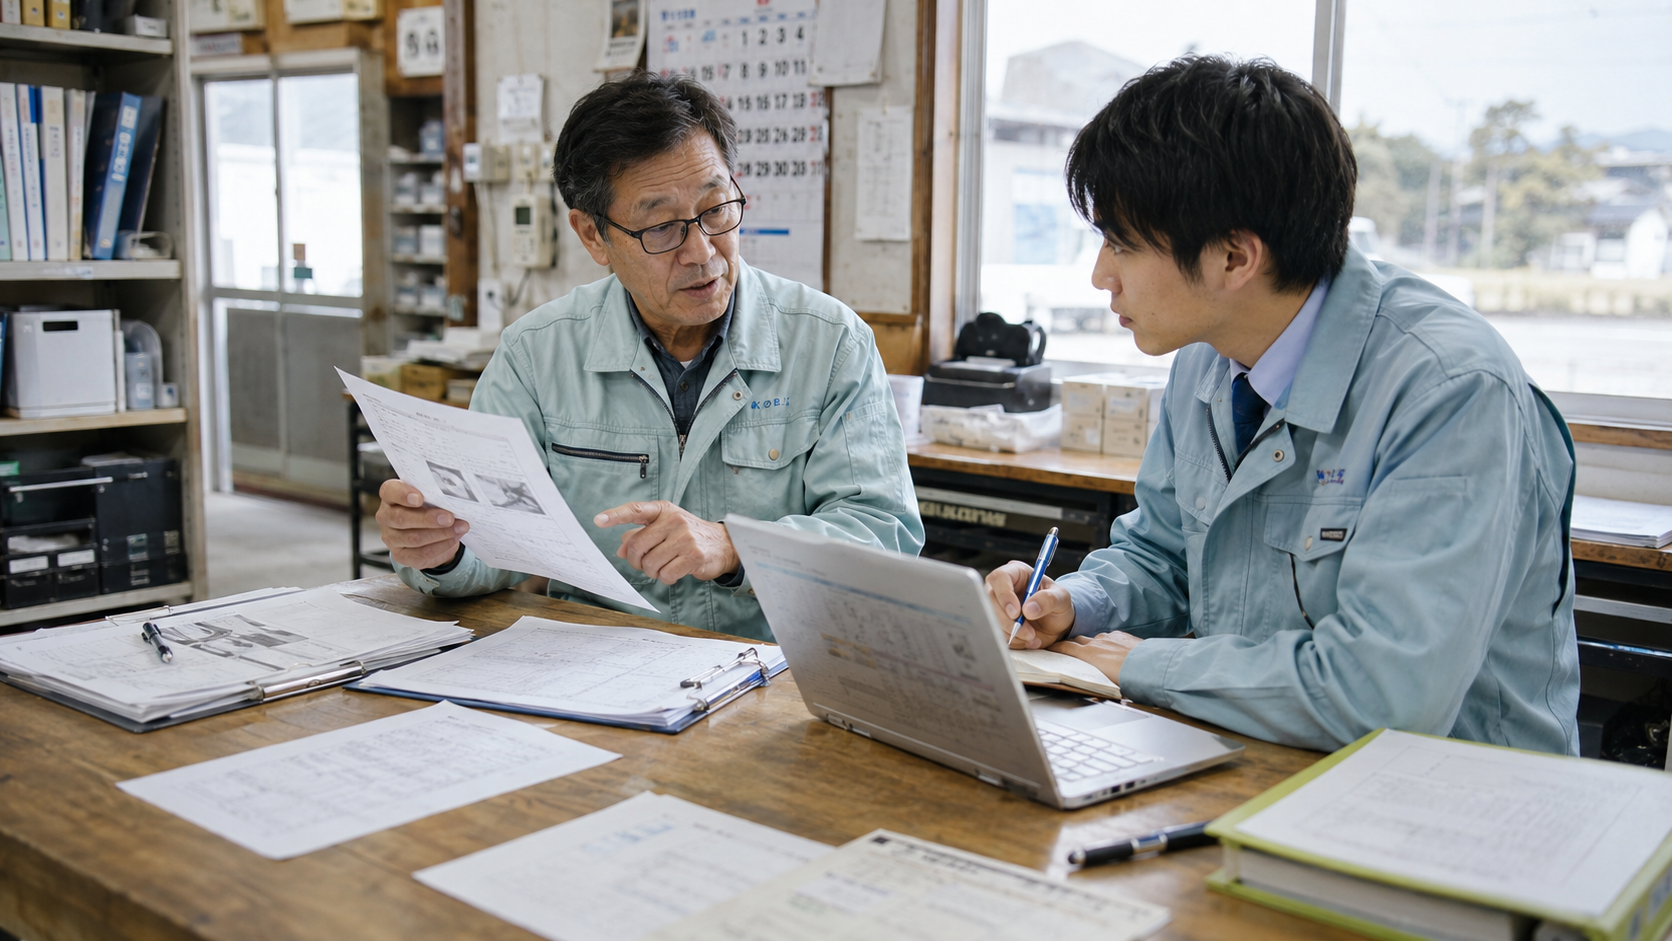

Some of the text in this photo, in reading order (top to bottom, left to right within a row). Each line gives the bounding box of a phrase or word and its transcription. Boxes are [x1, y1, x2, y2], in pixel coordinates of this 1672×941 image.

[741, 26, 804, 46] 1 2 3 4
[740, 62, 749, 79] 8
[757, 61, 767, 78] 9
[775, 60, 789, 77] 10
[794, 60, 806, 76] 11
[738, 94, 752, 111] 15
[756, 93, 771, 110] 16
[774, 93, 788, 109] 17
[755, 160, 770, 177] 29
[773, 160, 788, 177] 30
